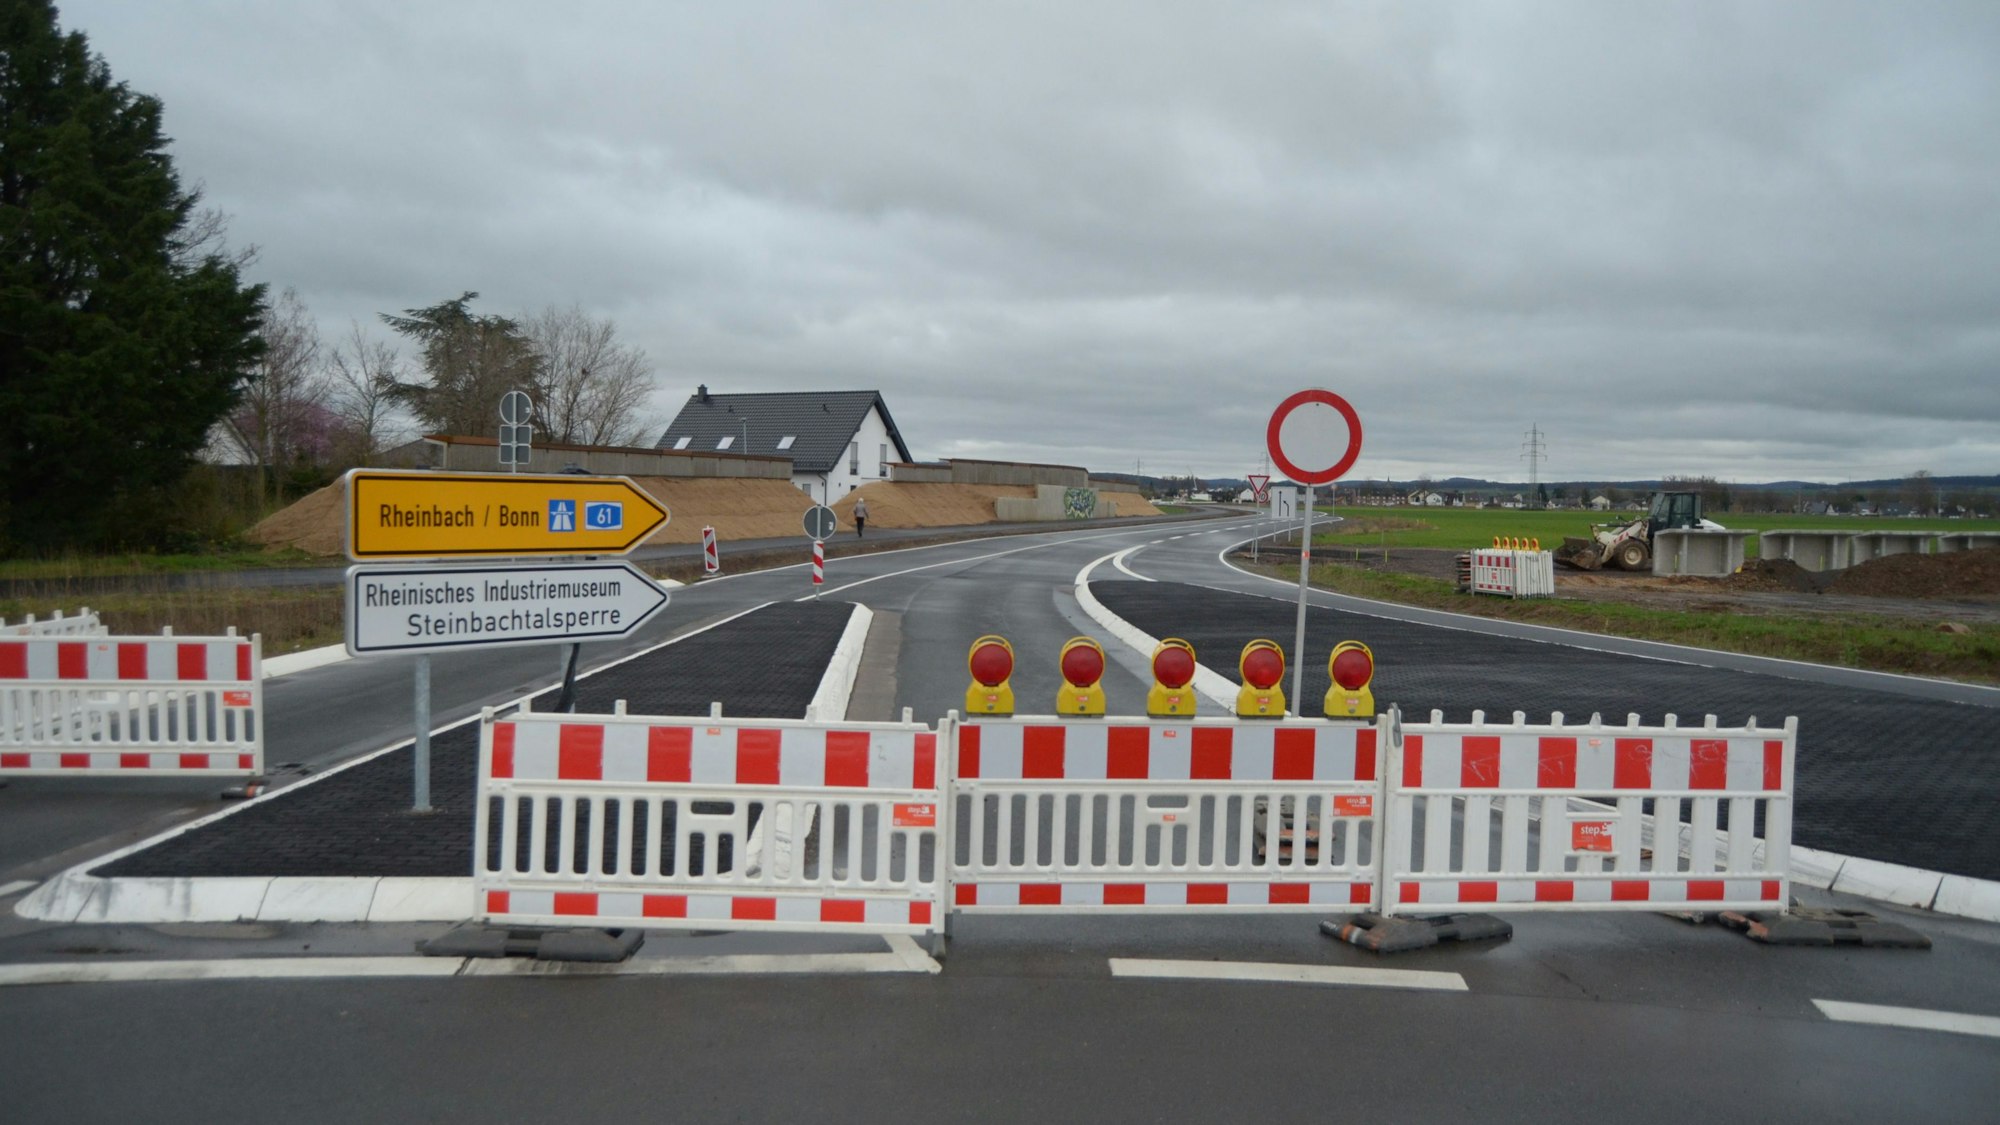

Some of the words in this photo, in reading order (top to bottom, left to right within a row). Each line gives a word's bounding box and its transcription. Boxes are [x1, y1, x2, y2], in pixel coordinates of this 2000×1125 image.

[380, 504, 474, 527] Rheinbach
[500, 504, 540, 527] Bonn
[597, 507, 612, 525] 61
[366, 581, 475, 606] Rheinisches
[484, 578, 621, 601] Industriemuseum
[408, 607, 620, 636] Steinbachtalsperre
